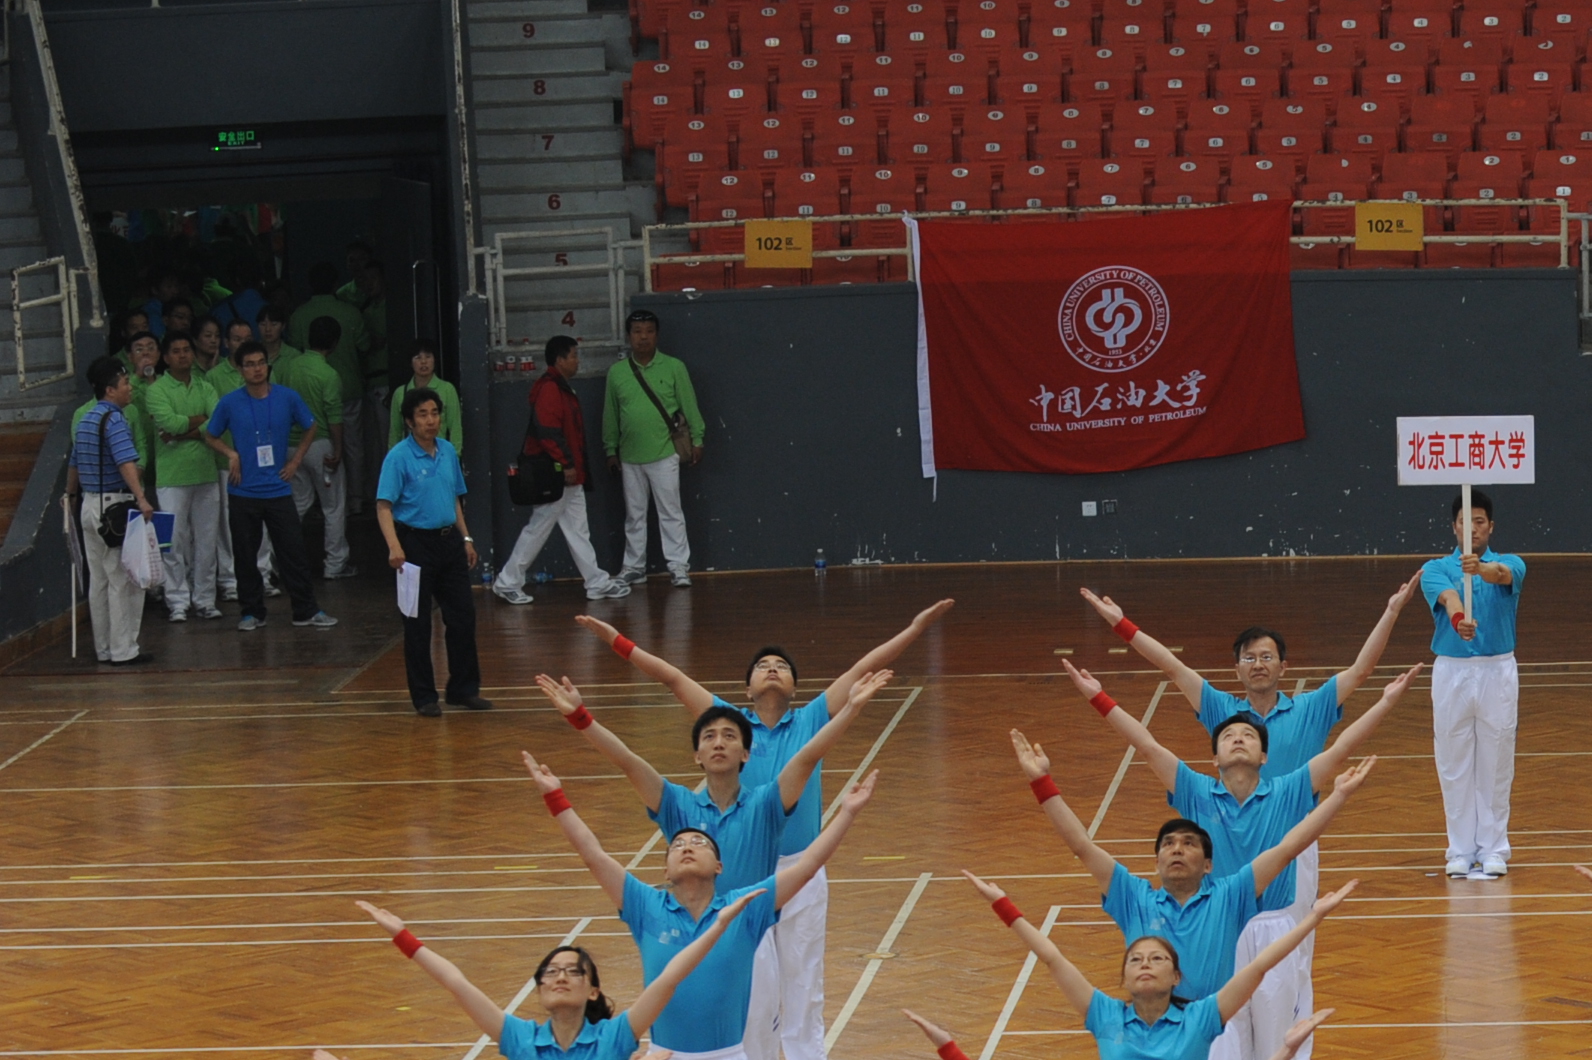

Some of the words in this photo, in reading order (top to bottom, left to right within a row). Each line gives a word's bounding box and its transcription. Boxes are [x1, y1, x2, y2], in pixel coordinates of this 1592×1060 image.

[522, 23, 535, 38] 9
[534, 80, 546, 95] 8
[542, 135, 554, 150] 7
[548, 194, 560, 210] 6
[1367, 220, 1393, 233] 102
[756, 237, 782, 250] 102
[555, 254, 568, 266] 5
[1120, 270, 1136, 281] OF
[1067, 270, 1119, 306] UNIVERSITY
[1134, 274, 1166, 331] PETROLEUM
[561, 311, 576, 327] 4
[1062, 308, 1074, 341] CHINA
[1028, 369, 1206, 423] 中国石油大学
[1030, 422, 1062, 432] CHINA
[1066, 416, 1127, 431] UNIVERSITY
[1131, 415, 1145, 425] OF
[1148, 406, 1207, 423] PETROLEUM
[1408, 430, 1526, 470] 北京工商大学
